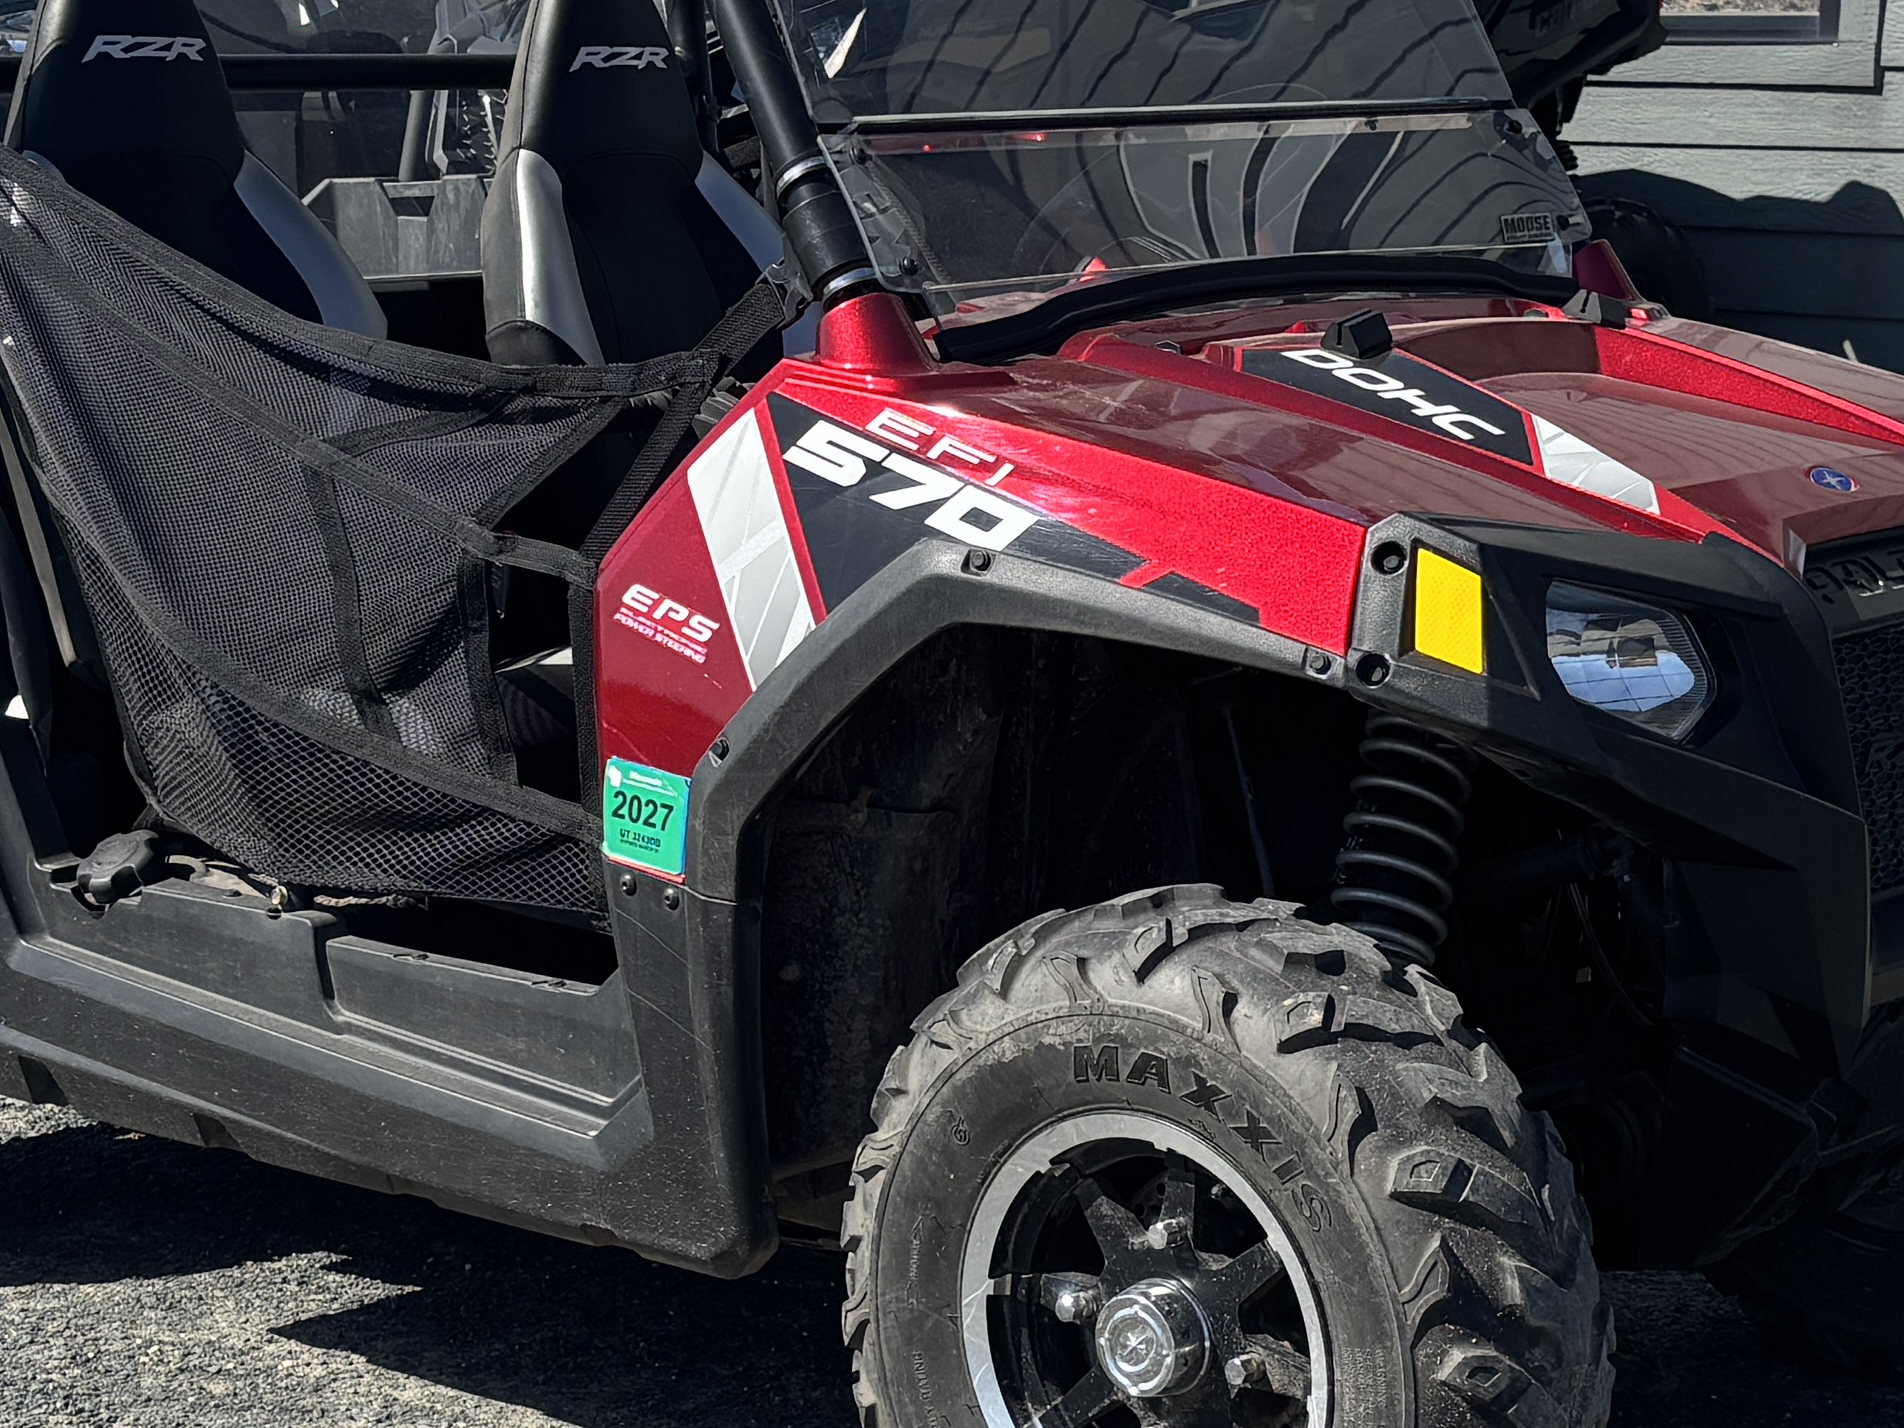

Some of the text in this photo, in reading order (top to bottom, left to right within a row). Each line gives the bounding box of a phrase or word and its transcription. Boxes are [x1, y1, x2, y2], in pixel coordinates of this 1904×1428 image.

[82, 35, 206, 63] RZR
[569, 46, 669, 72] RZR
[1503, 214, 1551, 234] MOOSE
[1280, 349, 1506, 441] DOHC
[864, 407, 1015, 487] EFI
[782, 419, 1041, 552] 570
[613, 612, 706, 664] POWER STEERING
[621, 583, 720, 643] EPS
[611, 790, 675, 832] 2027
[1072, 1044, 1332, 1233] MAXXIS
